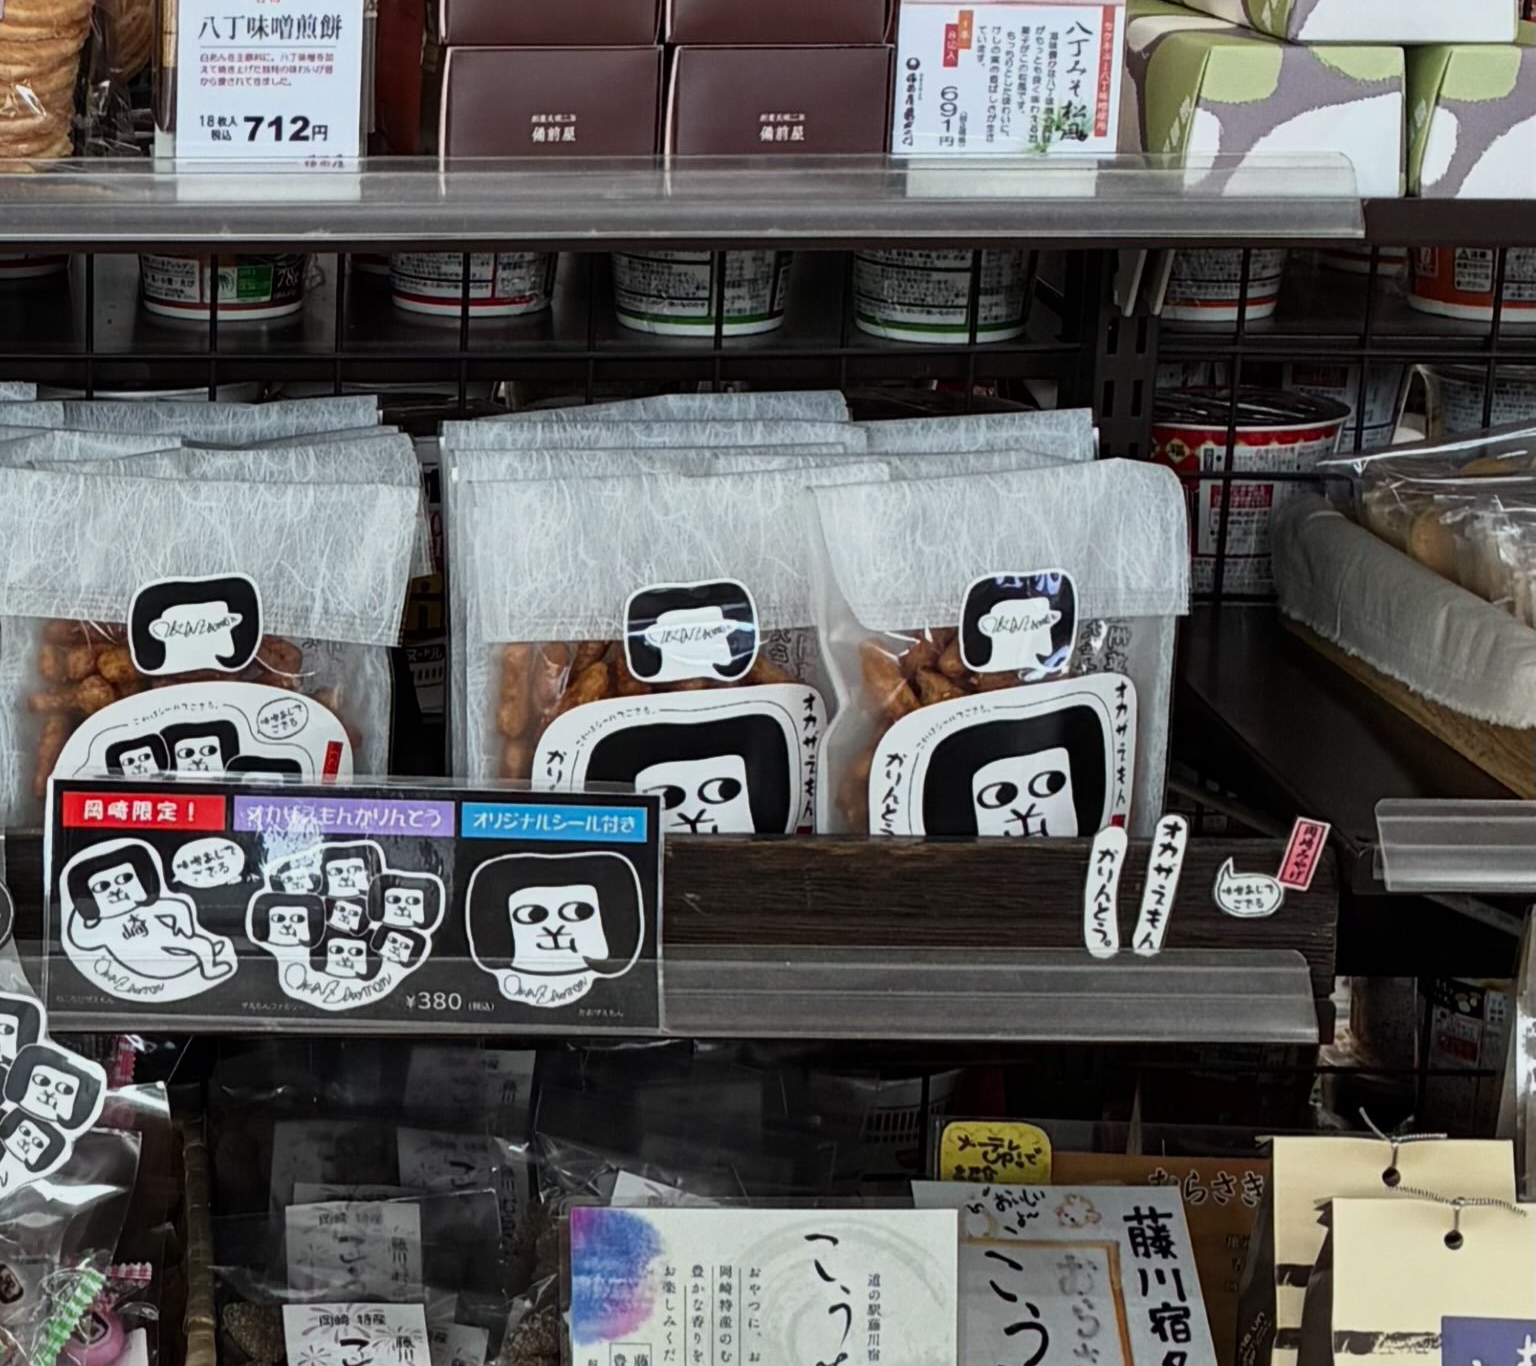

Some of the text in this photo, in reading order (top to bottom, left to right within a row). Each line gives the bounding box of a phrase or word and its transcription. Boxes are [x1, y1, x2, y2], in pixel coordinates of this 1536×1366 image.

[198, 13, 344, 42] 八丁味噌煎餅
[243, 115, 329, 142] 712円
[532, 125, 577, 143] 備前屋
[760, 124, 805, 142] 備前屋
[82, 800, 198, 825] 岡崎限定!
[470, 810, 639, 835] オリジナルシール付き
[1136, 821, 1186, 949] オカザえもん
[394, 990, 462, 1012] ¥380
[690, 1264, 706, 1364] 豊かな香りを
[867, 1272, 883, 1363] 道の駅藤川宿
